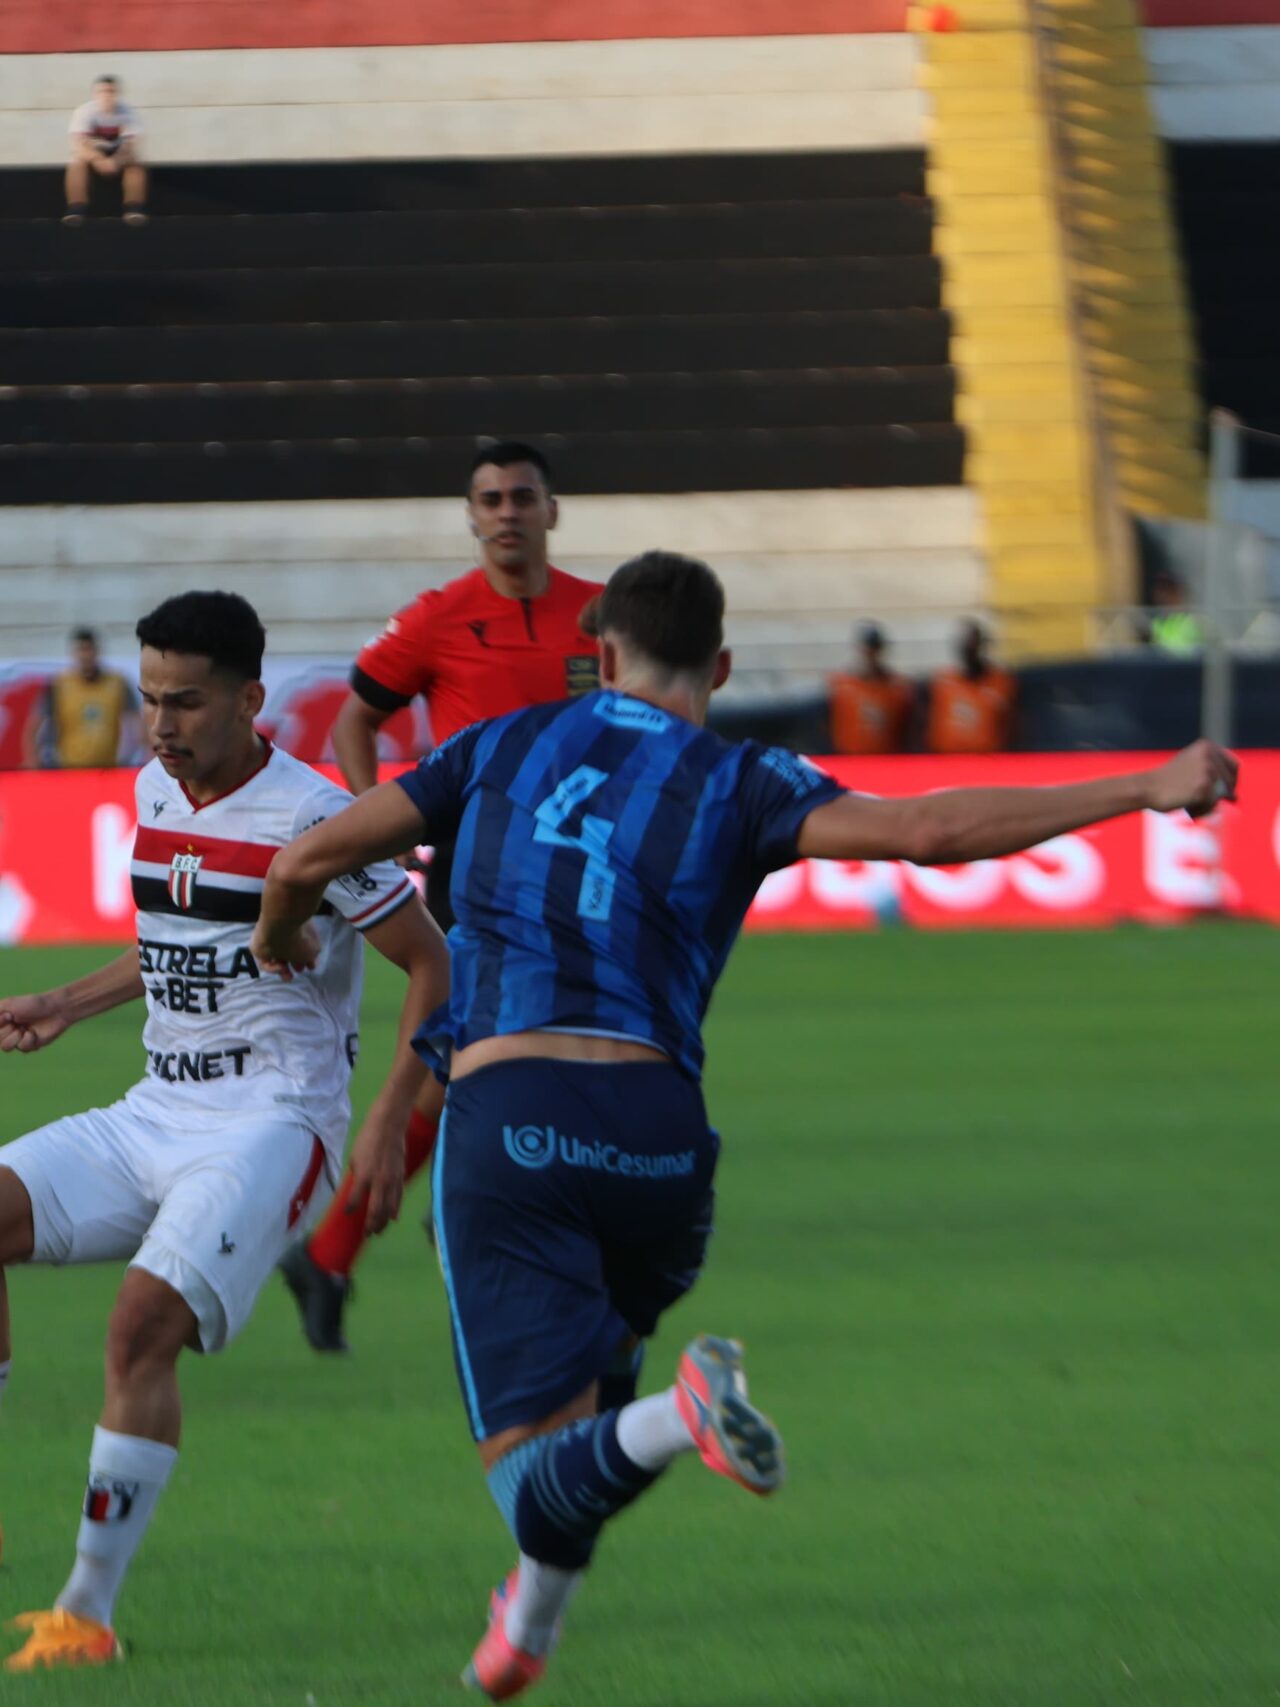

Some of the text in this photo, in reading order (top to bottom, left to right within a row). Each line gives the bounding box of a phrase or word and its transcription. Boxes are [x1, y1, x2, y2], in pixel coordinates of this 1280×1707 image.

[532, 764, 616, 922] 4
[166, 977, 225, 1014] BET
[559, 1135, 696, 1178] UniCesumar
